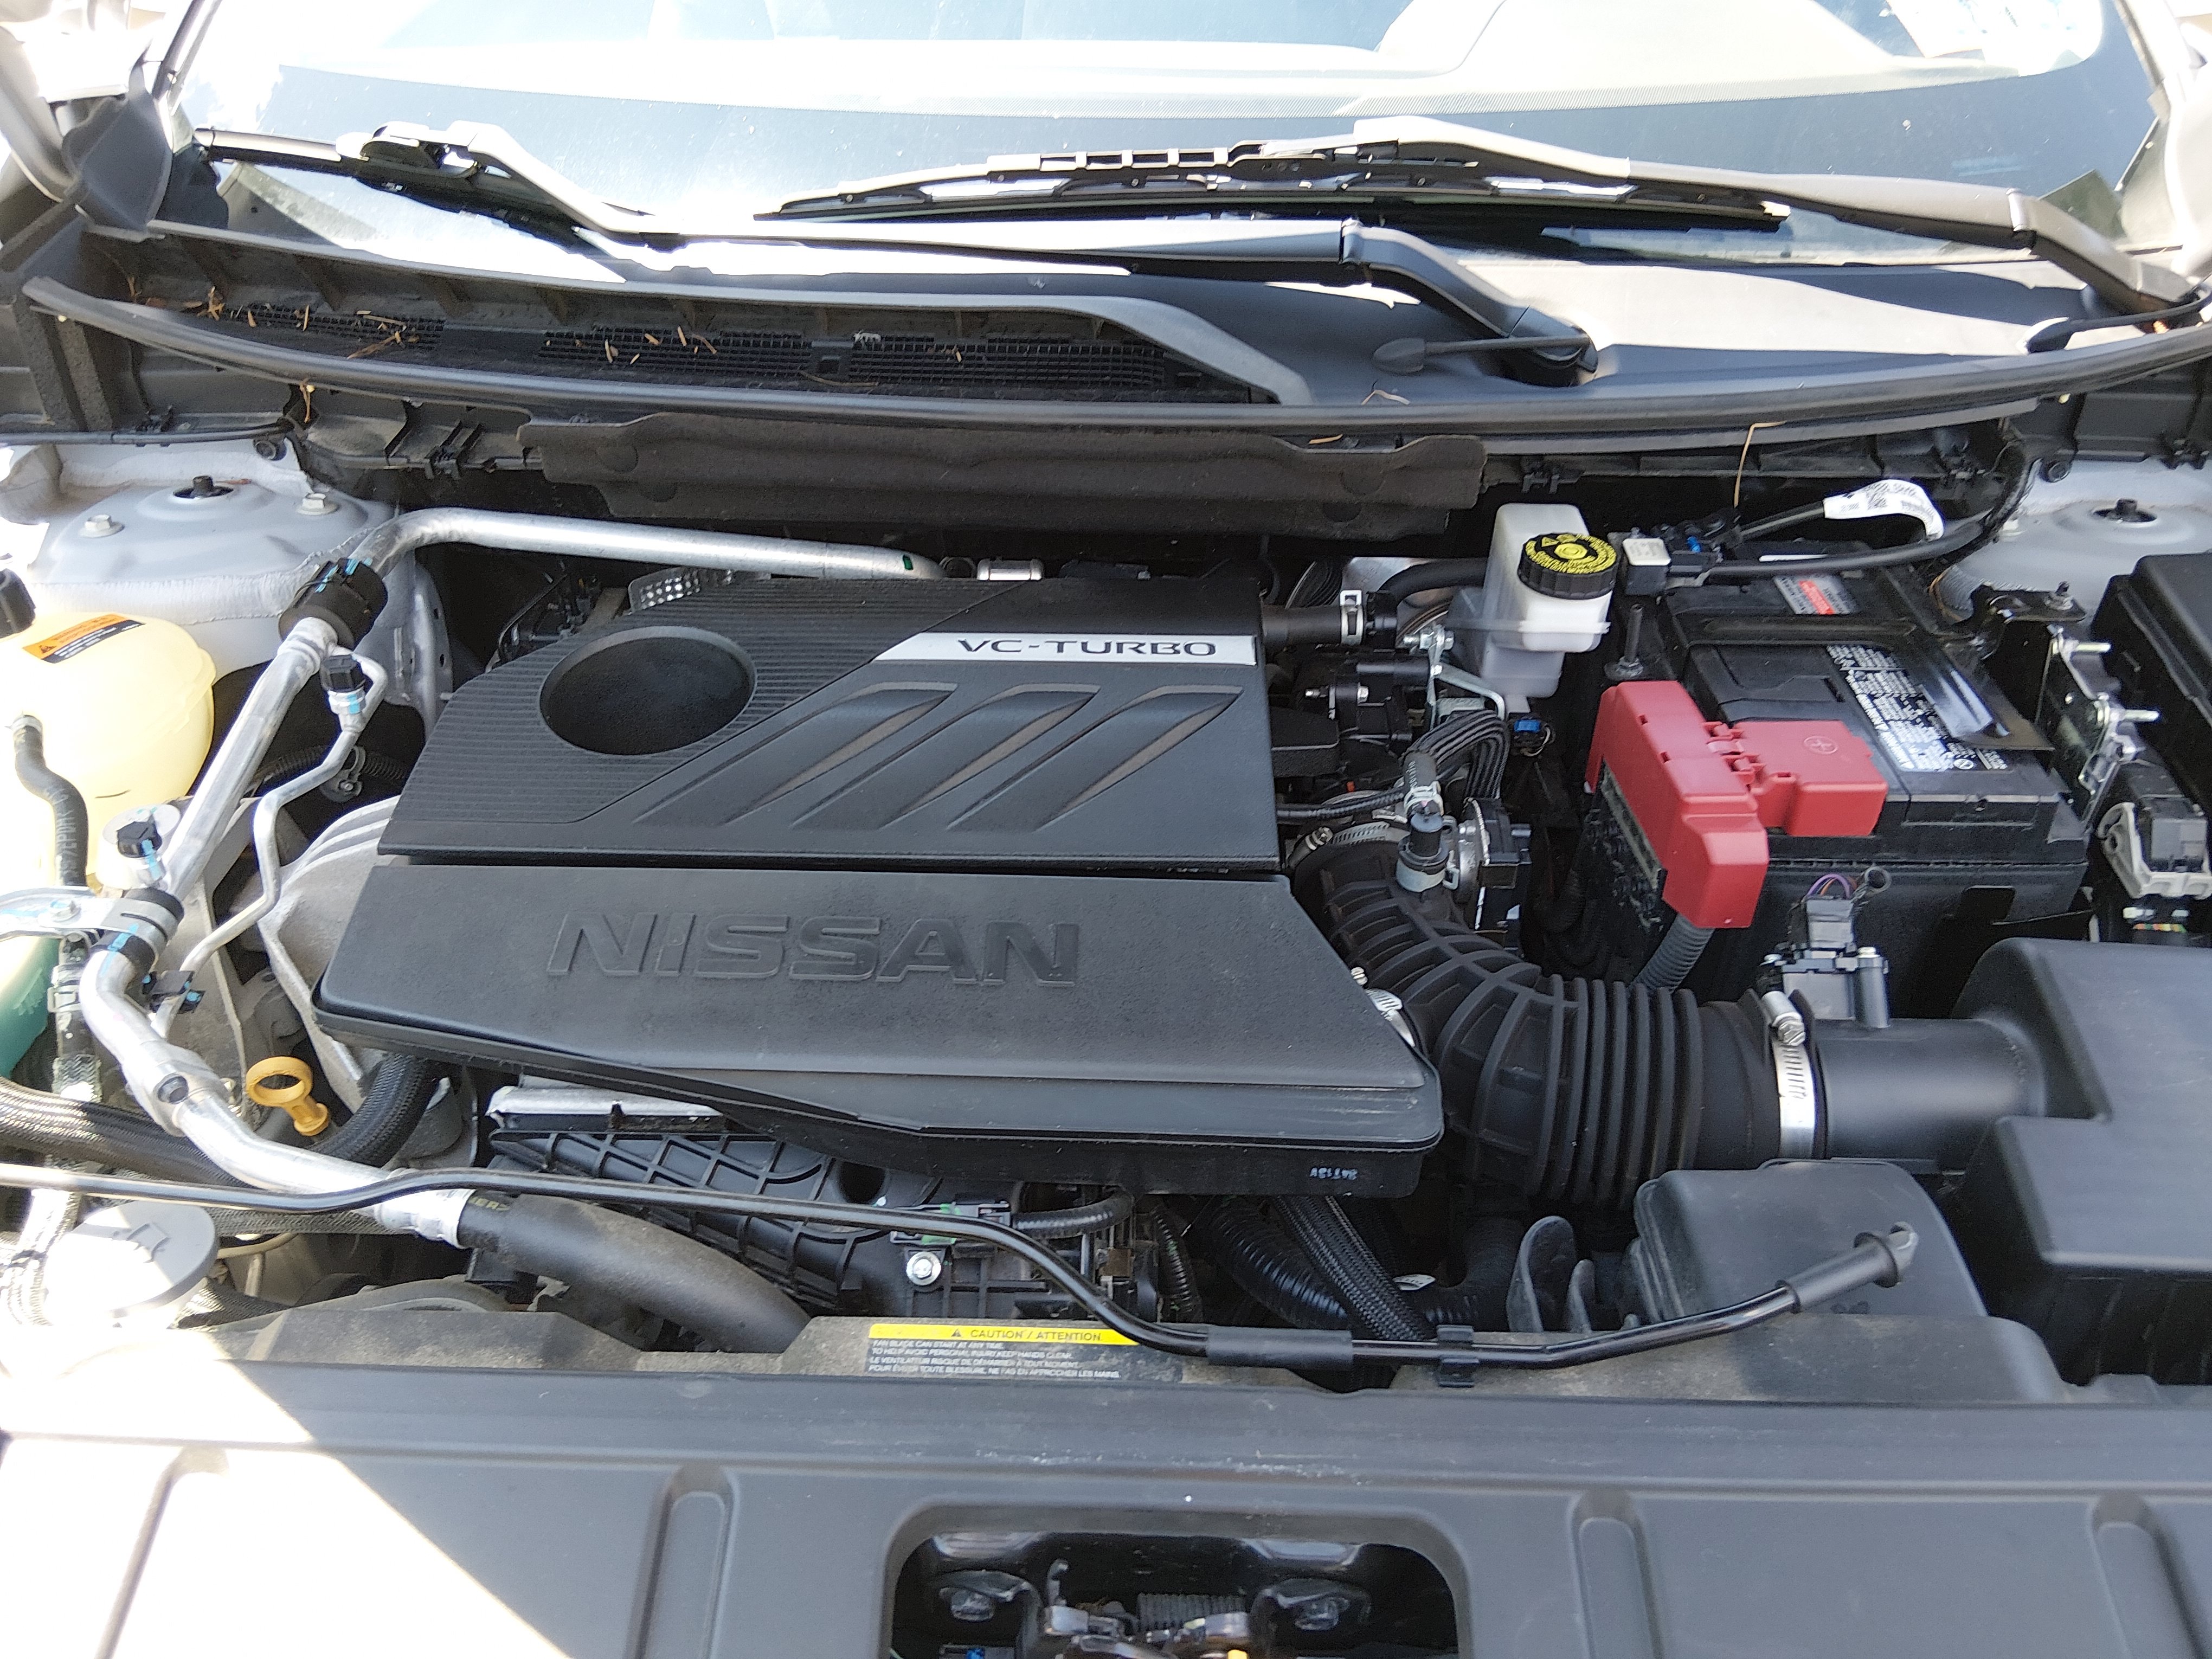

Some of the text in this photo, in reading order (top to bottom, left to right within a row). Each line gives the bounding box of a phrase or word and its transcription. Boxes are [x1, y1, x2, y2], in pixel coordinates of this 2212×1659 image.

[957, 639, 1217, 656] VC-TURBO
[546, 912, 1080, 987] NISSAN
[970, 1329, 1101, 1341] CAUTION / ATTENTION
